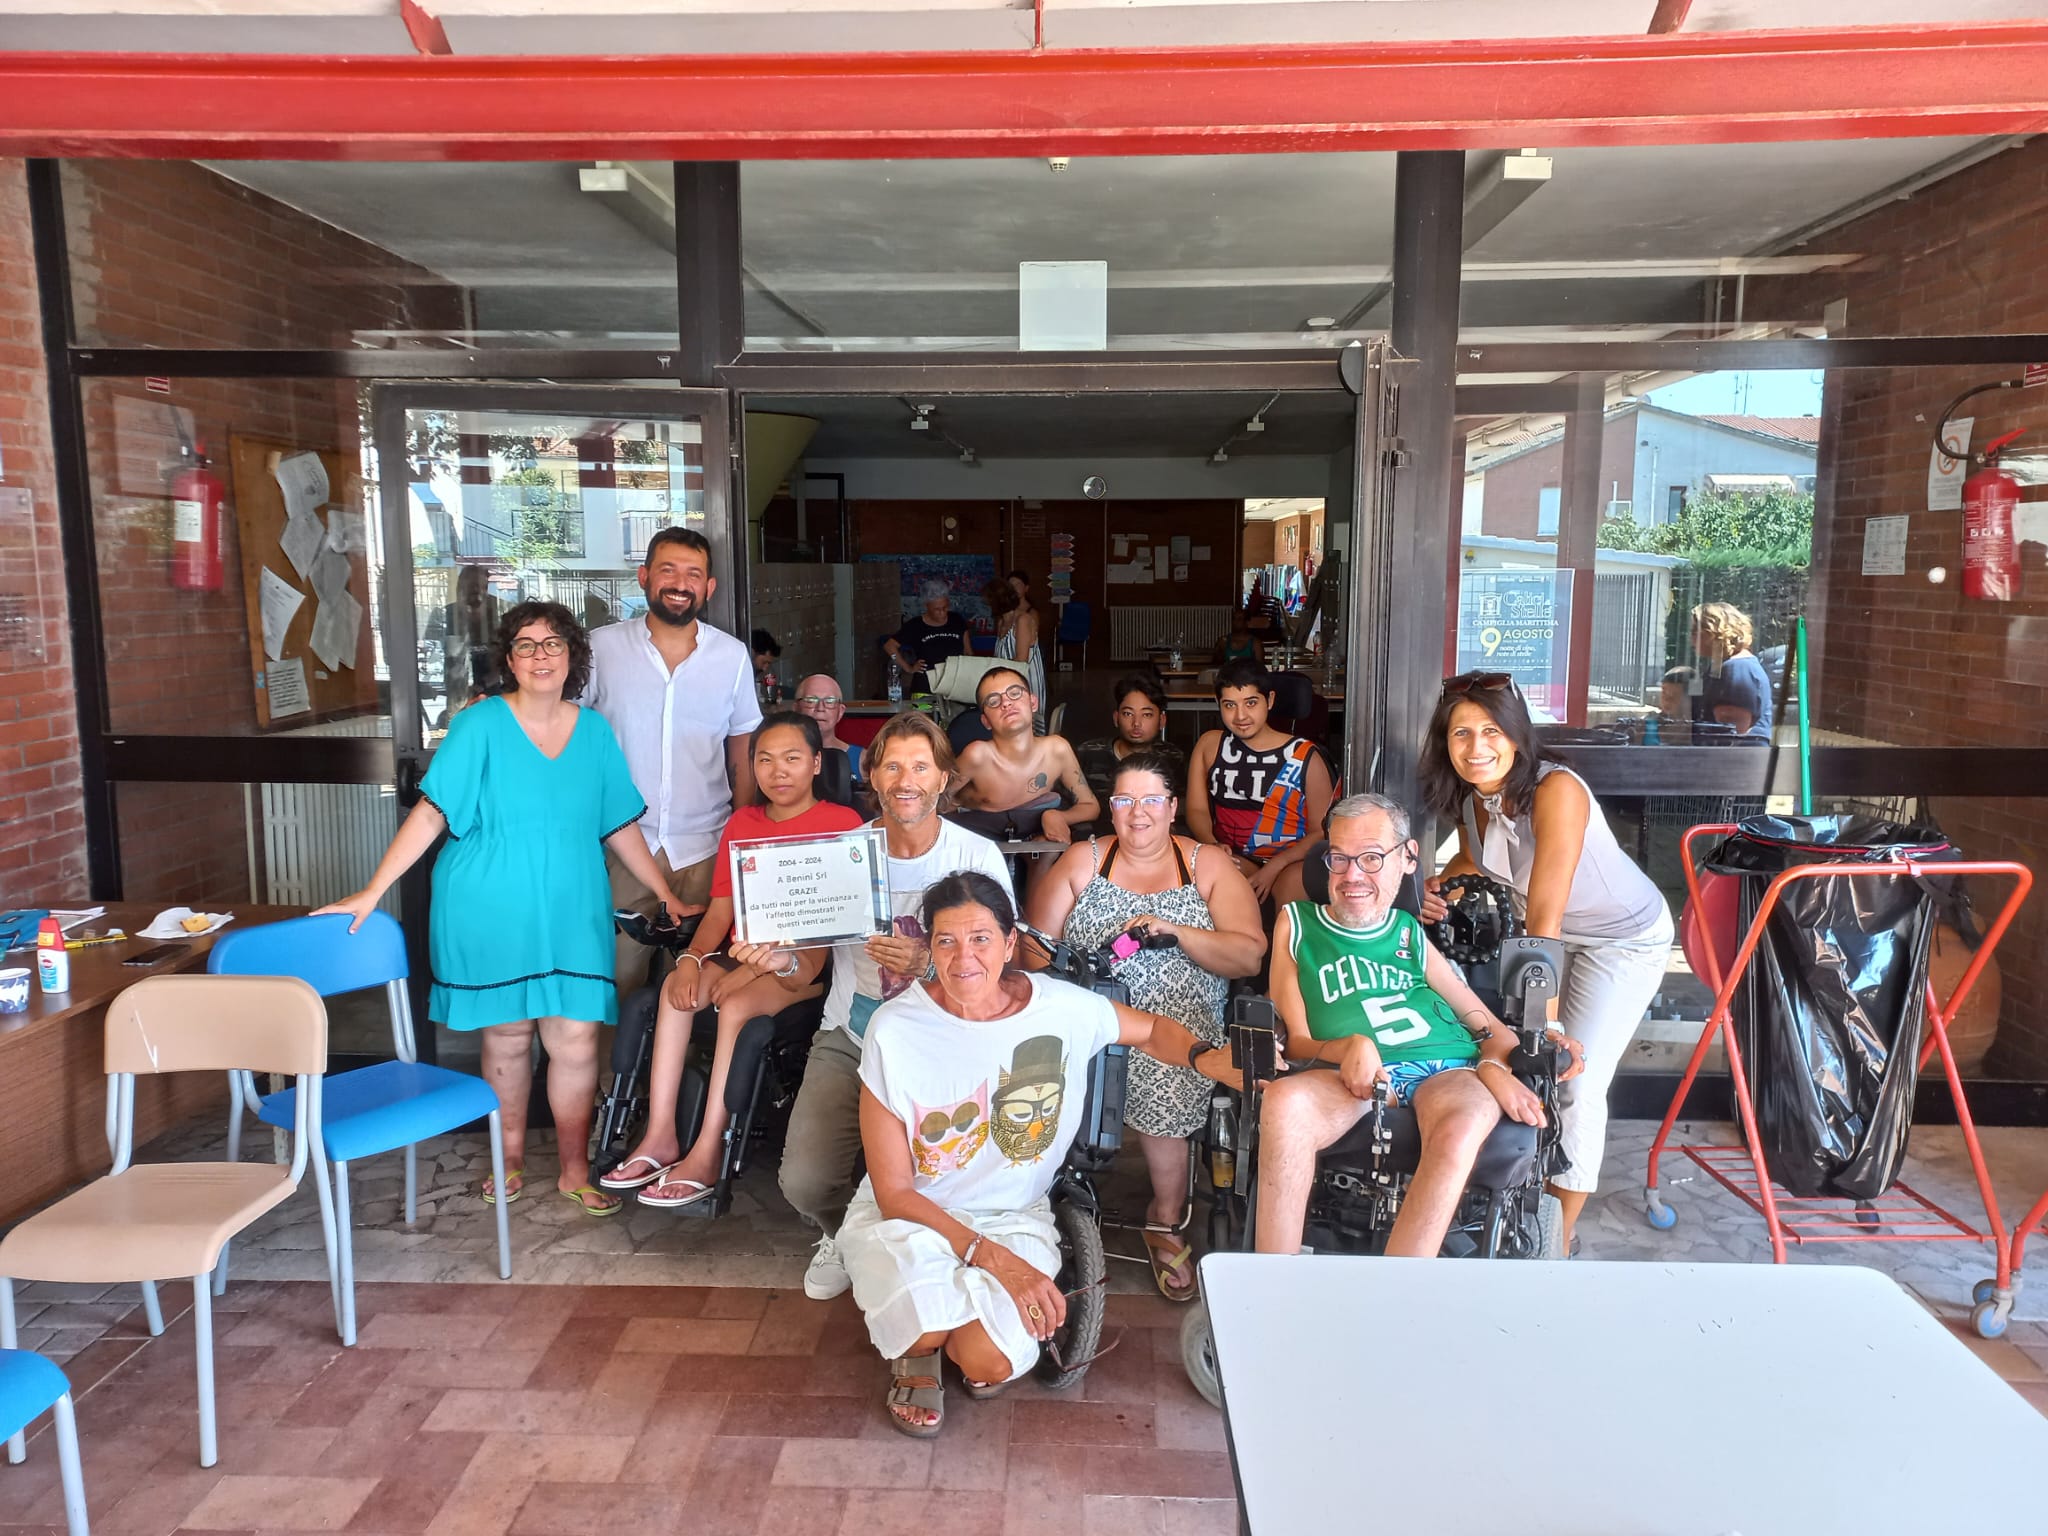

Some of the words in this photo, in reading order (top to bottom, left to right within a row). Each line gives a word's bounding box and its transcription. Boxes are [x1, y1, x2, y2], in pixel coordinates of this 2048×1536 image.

[1480, 626, 1502, 657] 9
[1503, 629, 1554, 639] AGOSTO
[778, 859, 797, 867] 2004
[777, 876, 783, 884] A
[786, 873, 813, 883] Benini
[816, 871, 827, 881] Srl
[788, 886, 818, 896] GRAZIE
[749, 903, 760, 911] da
[762, 901, 778, 910] tutti
[779, 899, 792, 907] noi
[794, 899, 806, 908] per
[817, 894, 851, 904] vicinanza
[765, 909, 795, 920] l'affetto
[797, 905, 835, 916] dimostrati
[776, 919, 800, 929] questi
[1360, 992, 1432, 1047] 5
